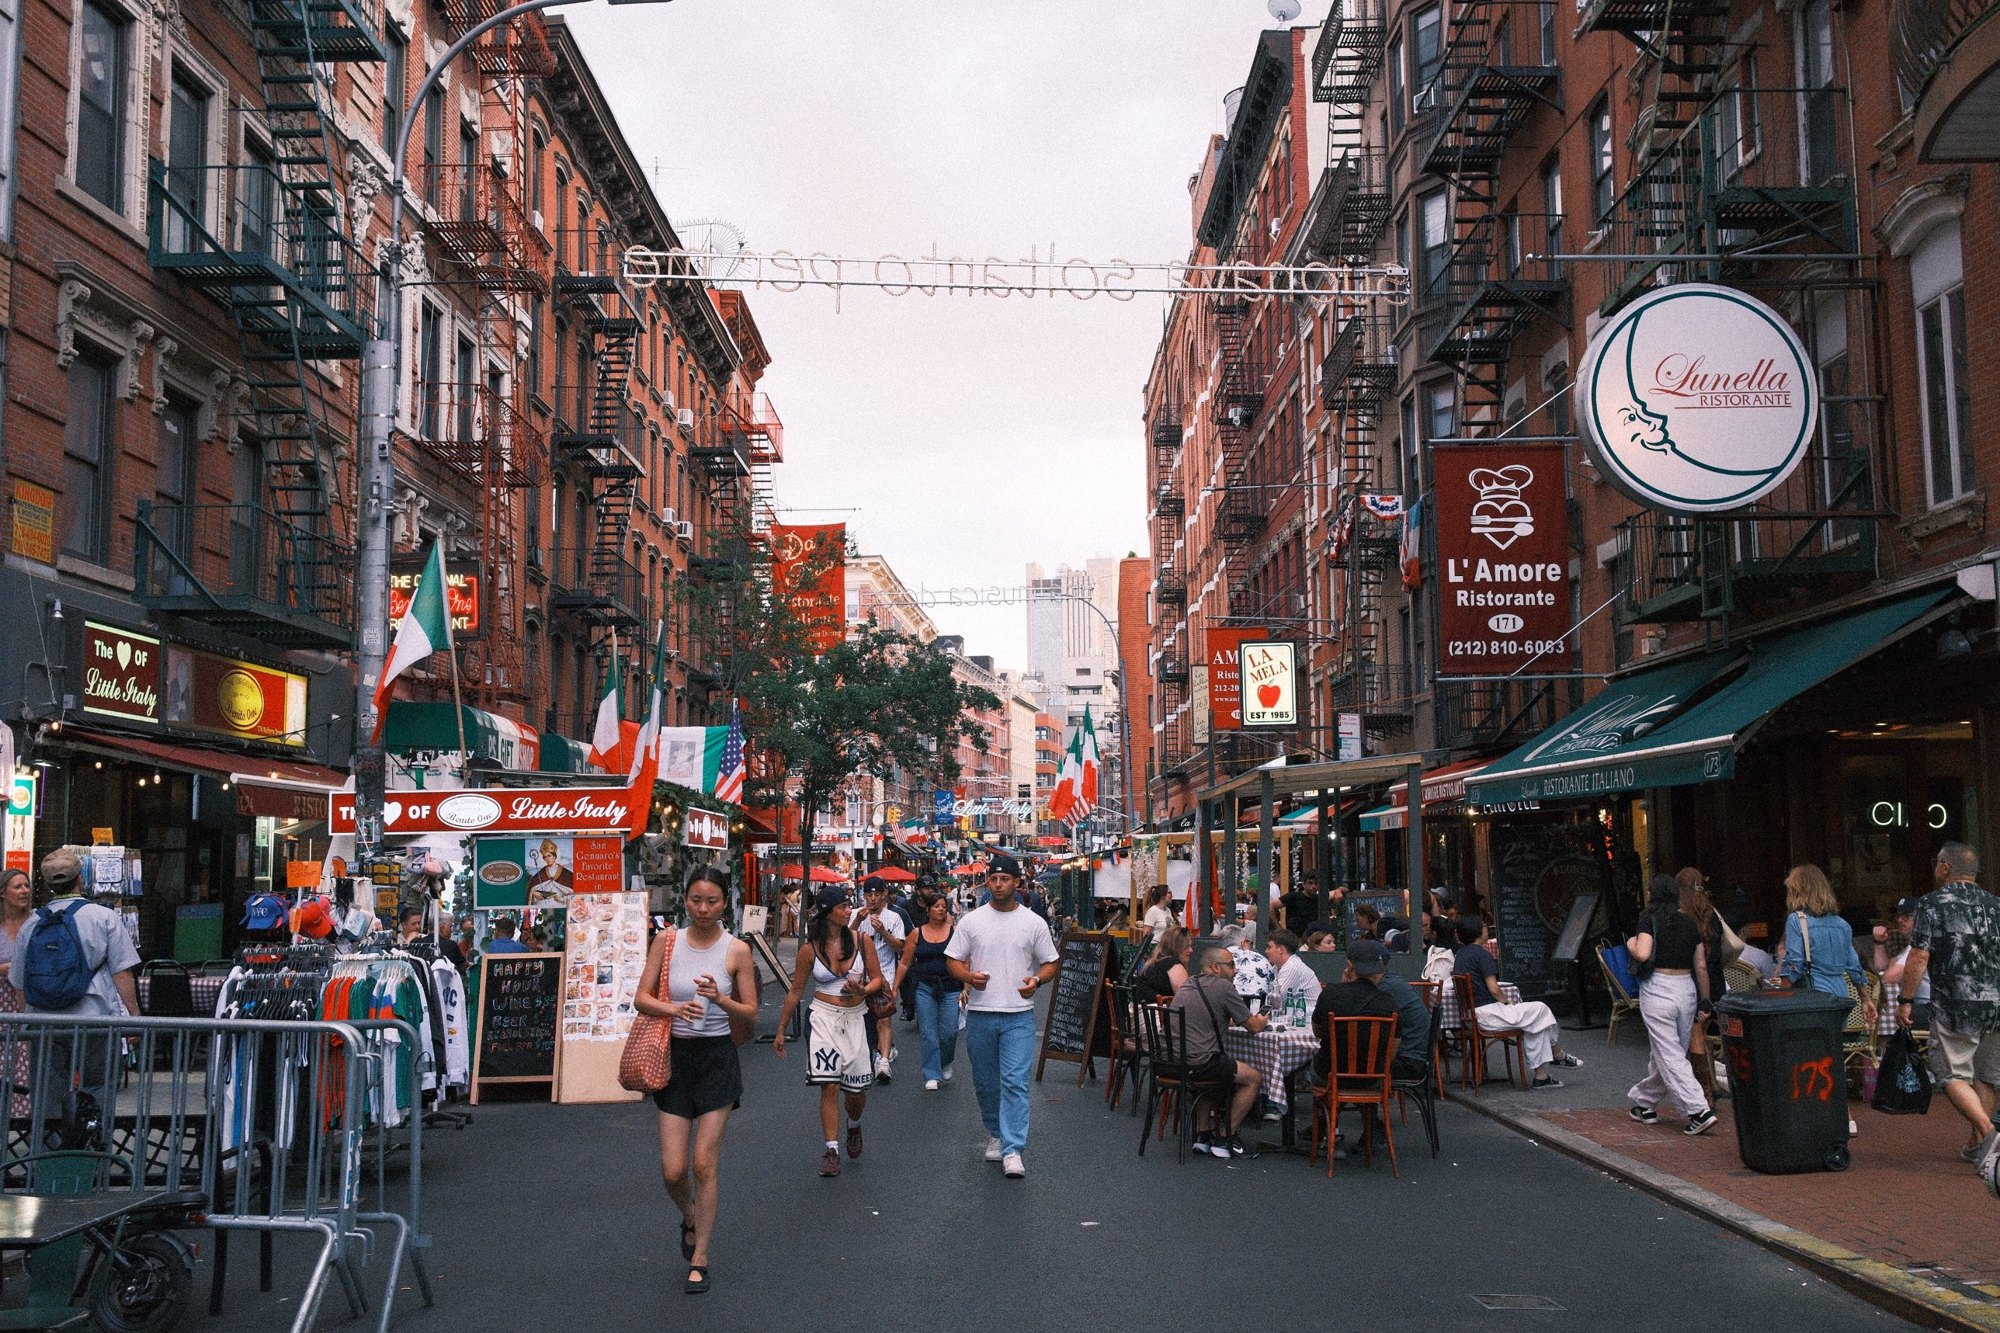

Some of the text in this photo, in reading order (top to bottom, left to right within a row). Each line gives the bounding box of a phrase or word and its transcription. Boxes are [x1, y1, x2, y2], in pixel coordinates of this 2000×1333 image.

[1648, 353, 1792, 398] Lunella
[1699, 393, 1792, 407] RISTORANTE
[1448, 558, 1562, 583] L'Amore
[1456, 589, 1556, 607] Ristorante
[1494, 616, 1517, 630] 171
[94, 639, 148, 667] The OF
[1449, 641, 1487, 656] (212)
[1248, 648, 1274, 669] LA
[1249, 660, 1289, 684] MELA
[84, 667, 157, 717] Little Italy
[1250, 711, 1290, 719] EST 1985
[1543, 773, 1589, 796] RISTORANTE
[1592, 767, 1635, 791] ITALIANO
[408, 805, 431, 820] OF
[508, 797, 567, 820] Little
[568, 796, 627, 826] Italy
[591, 840, 607, 850] San
[576, 851, 620, 860] Gennaro's
[581, 862, 614, 871] Favorite
[575, 872, 619, 881] Restaurant
[493, 960, 545, 977] HAPPY
[814, 1047, 840, 1072] NY
